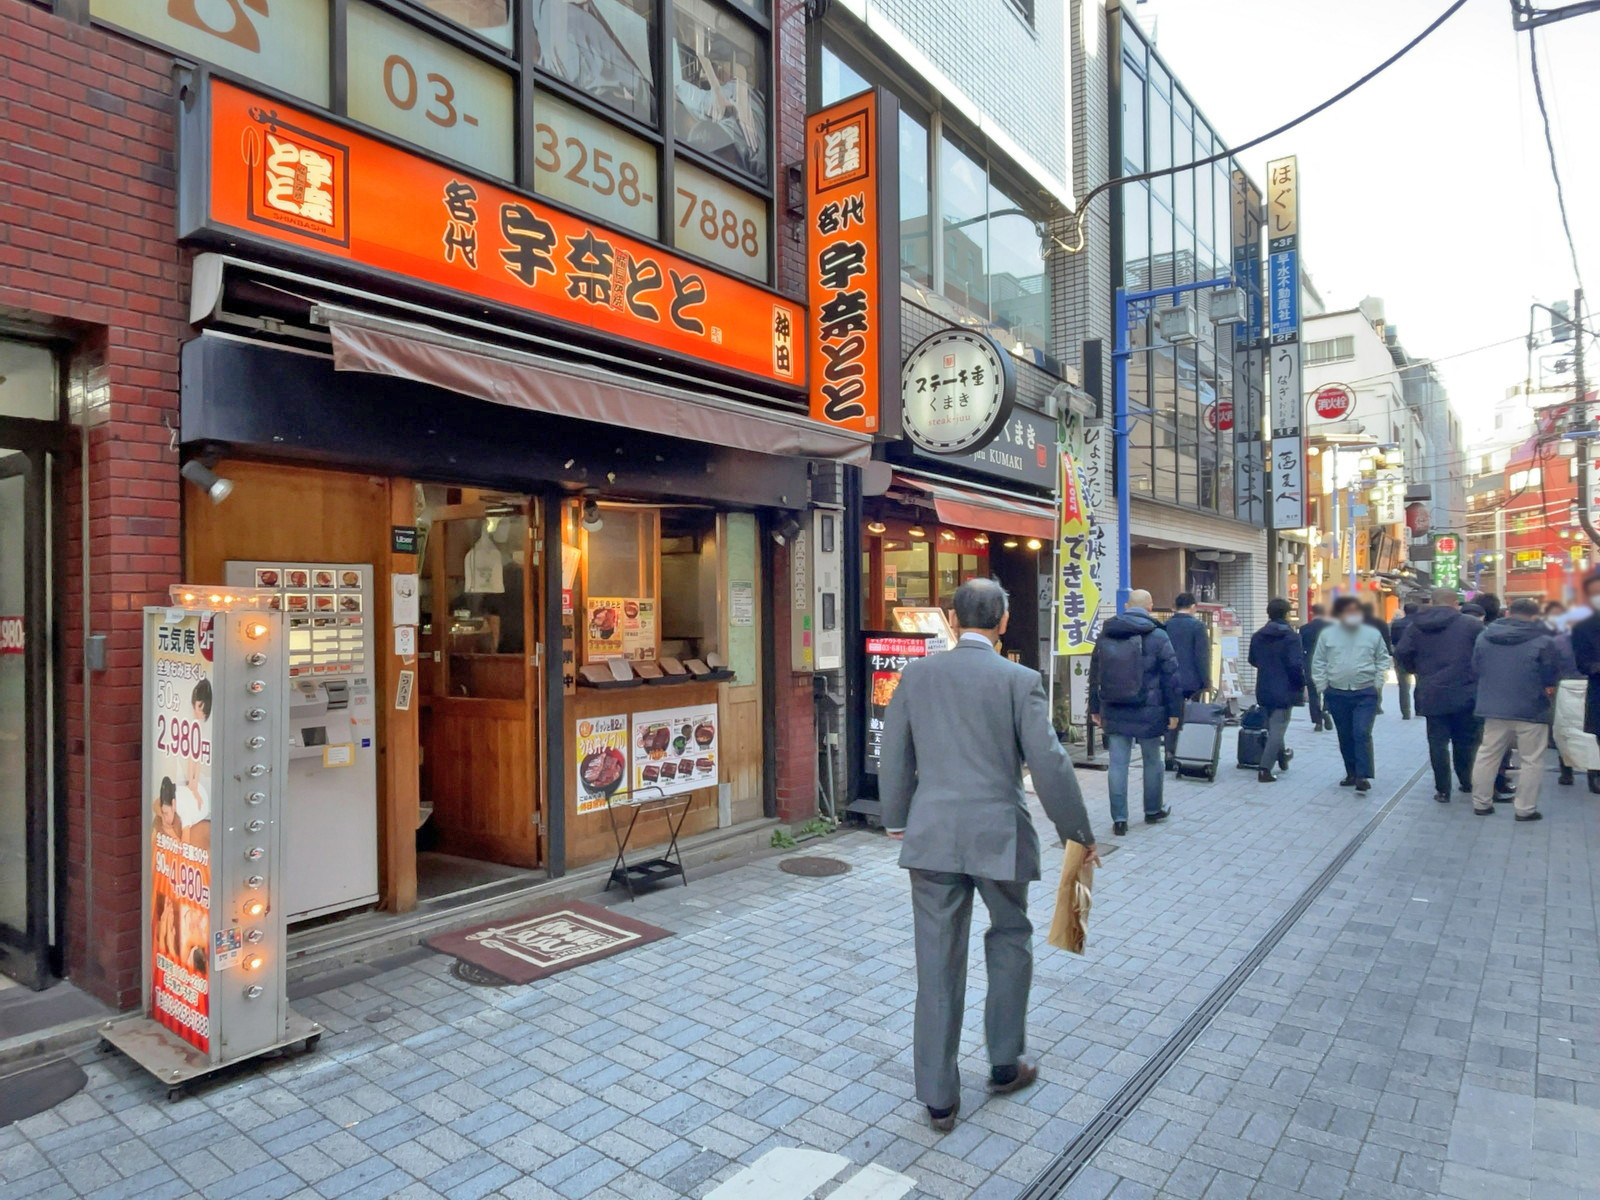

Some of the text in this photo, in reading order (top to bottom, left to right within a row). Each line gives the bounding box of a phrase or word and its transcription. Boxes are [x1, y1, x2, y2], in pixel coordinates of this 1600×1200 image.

[1272, 164, 1293, 232] ほぐし
[272, 212, 327, 234] SHINBASHI
[442, 180, 479, 270] 名代
[816, 191, 865, 236] 名代
[774, 310, 792, 374] 神田
[818, 239, 869, 422] 宇奈とと
[1276, 333, 1293, 344] 2F
[915, 364, 985, 394] ステーキ重
[929, 392, 970, 412] くまき
[1317, 396, 1347, 412] 消火栓
[989, 448, 1023, 471] KUMAKI
[1061, 533, 1088, 647] できます
[158, 626, 196, 655] 元気庵
[156, 658, 207, 681] 全身もみほぐし
[871, 654, 920, 672] 牛バラ
[157, 679, 181, 712] 50分
[157, 713, 212, 765] 2,980円
